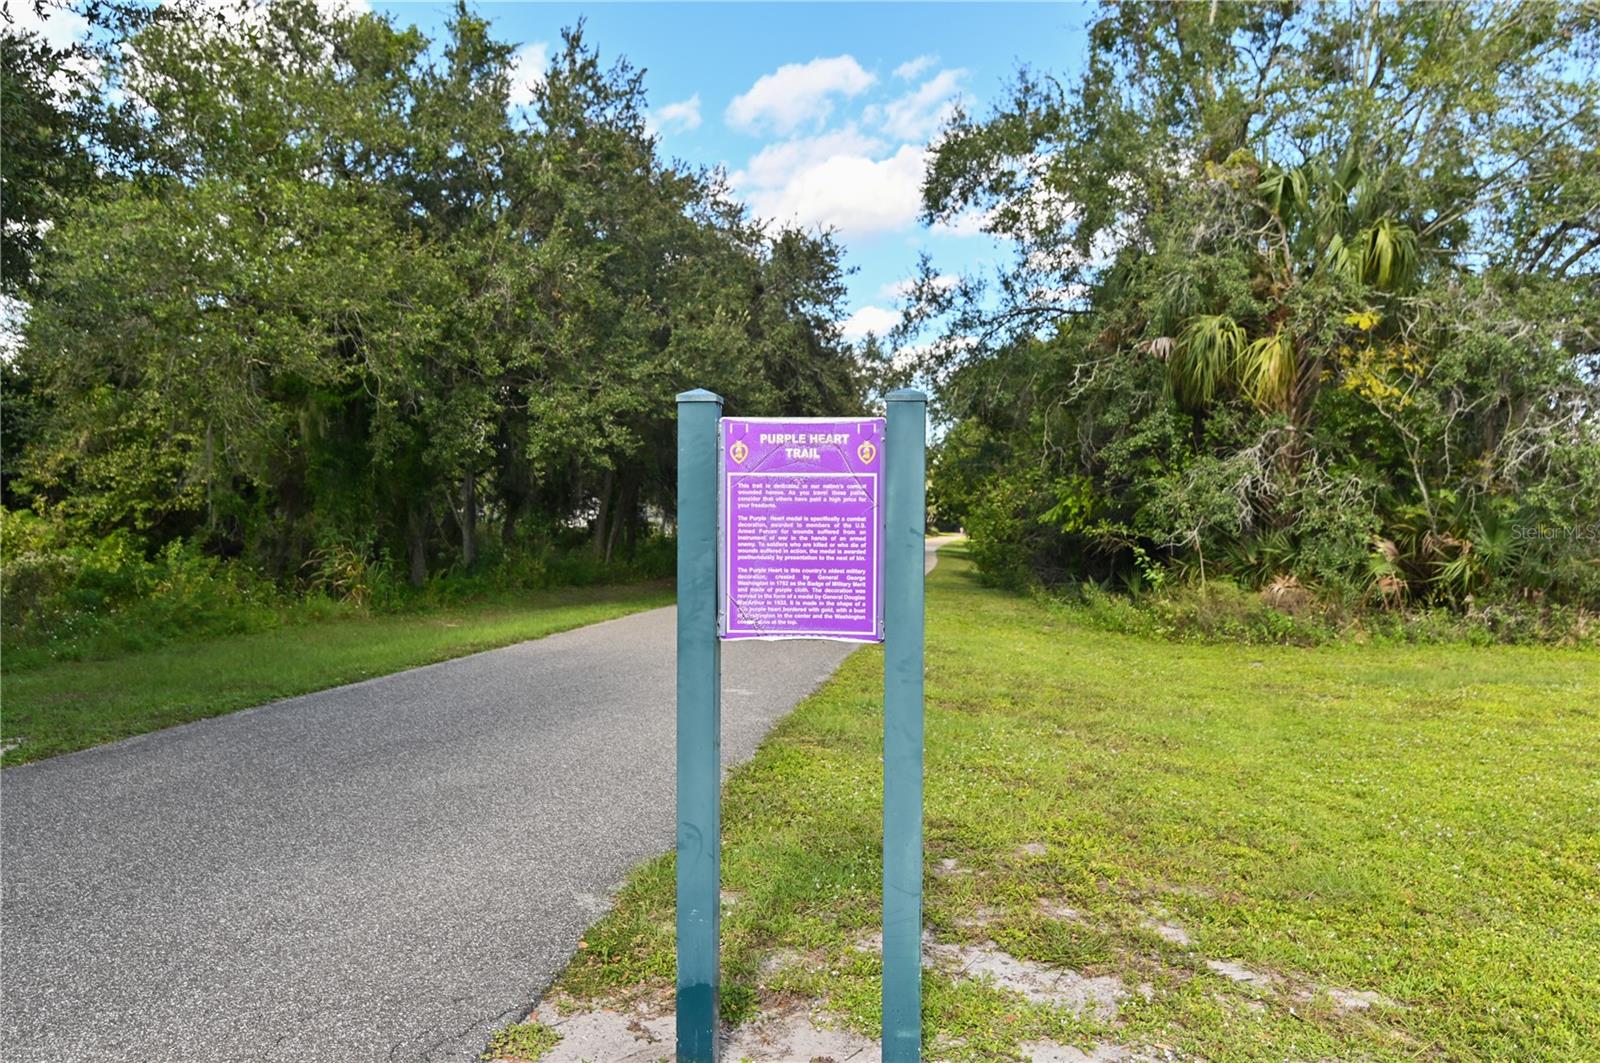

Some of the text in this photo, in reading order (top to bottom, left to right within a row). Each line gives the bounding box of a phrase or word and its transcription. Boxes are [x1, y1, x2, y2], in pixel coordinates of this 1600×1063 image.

[760, 434, 850, 444] PURPLE HEART
[786, 448, 820, 458] TRAIL
